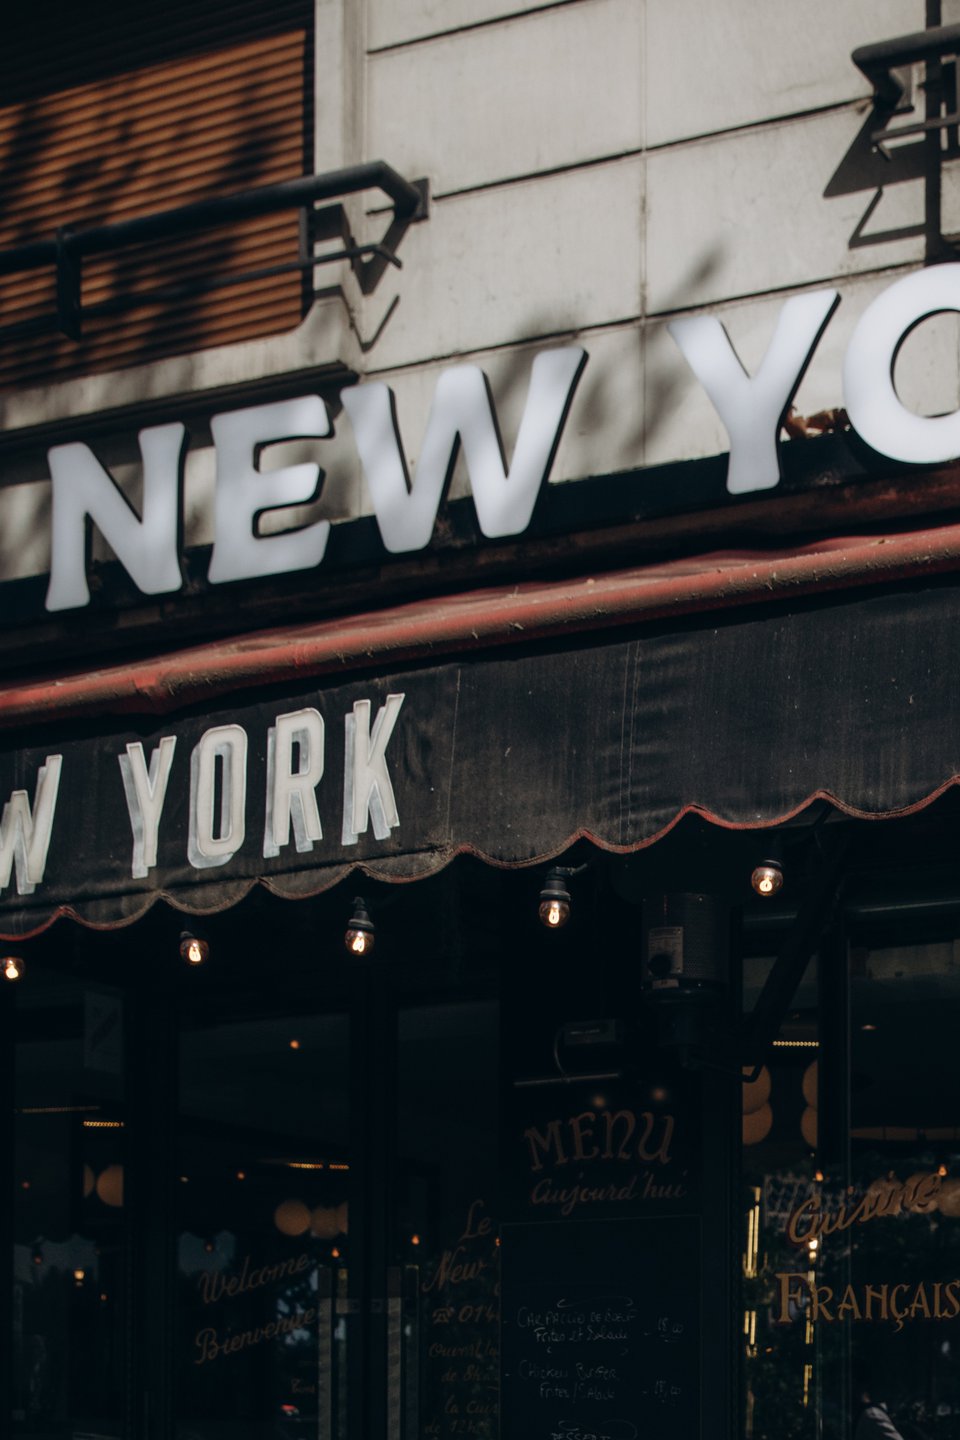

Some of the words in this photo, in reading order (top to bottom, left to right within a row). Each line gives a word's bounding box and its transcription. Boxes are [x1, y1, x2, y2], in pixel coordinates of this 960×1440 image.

[45, 345, 586, 612] NEW
[118, 694, 405, 878] YORK
[524, 1110, 674, 1171] MENU
[458, 1199, 491, 1242] Le
[788, 1173, 942, 1244] Cuisine
[198, 1254, 311, 1303] Welcome
[194, 1308, 316, 1364] Bienvenue
